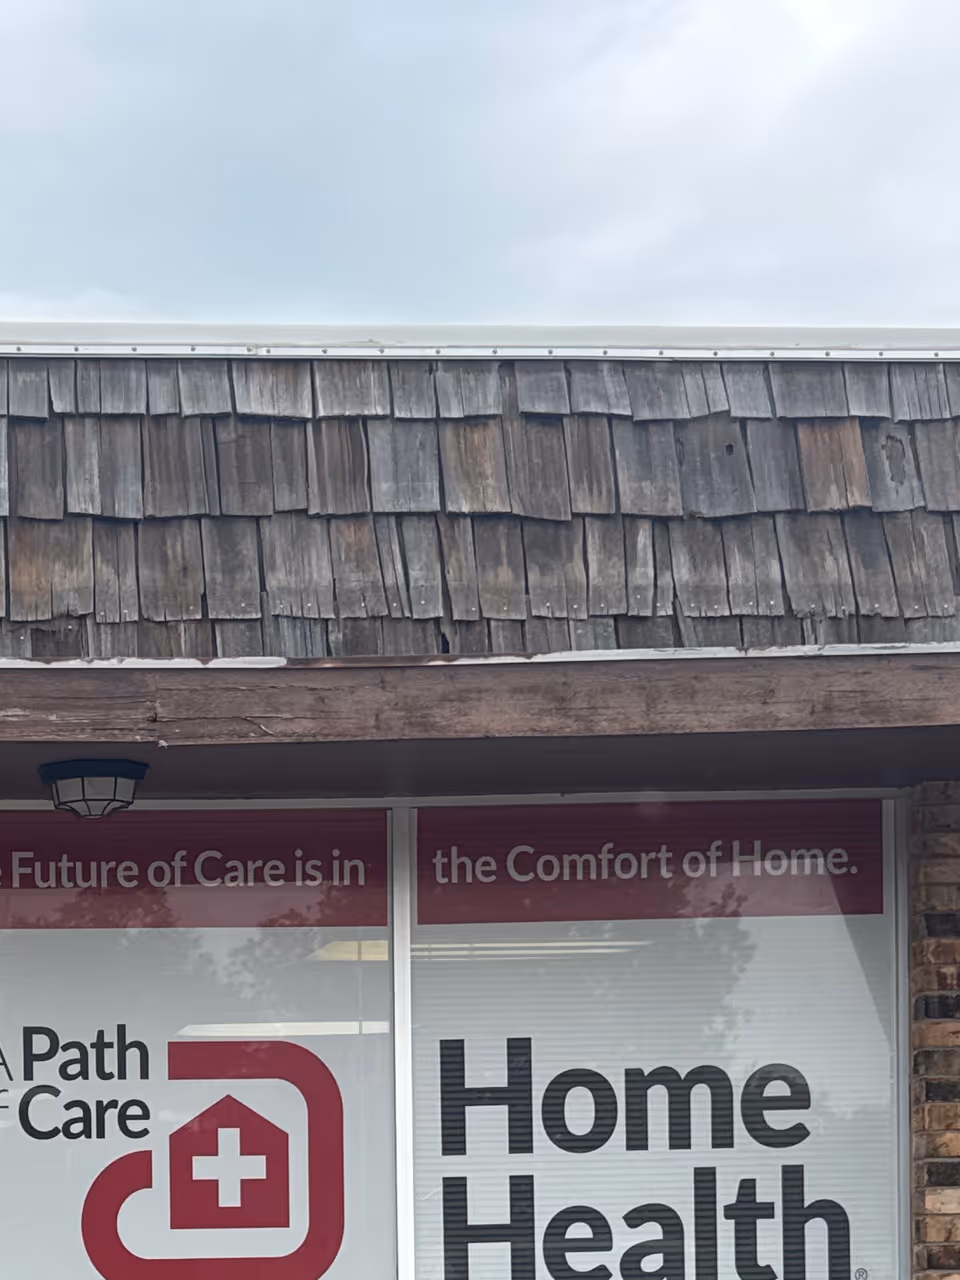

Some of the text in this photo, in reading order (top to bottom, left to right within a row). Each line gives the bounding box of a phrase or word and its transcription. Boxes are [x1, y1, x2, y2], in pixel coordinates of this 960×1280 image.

[11, 850, 139, 888] Future
[146, 849, 187, 887] of
[193, 849, 286, 887] Care
[293, 848, 323, 886] is
[332, 848, 366, 886] in
[432, 839, 858, 884] the Comfort of Home.
[22, 1023, 150, 1082] Path
[18, 1084, 151, 1141] Care
[439, 1037, 812, 1156] Home
